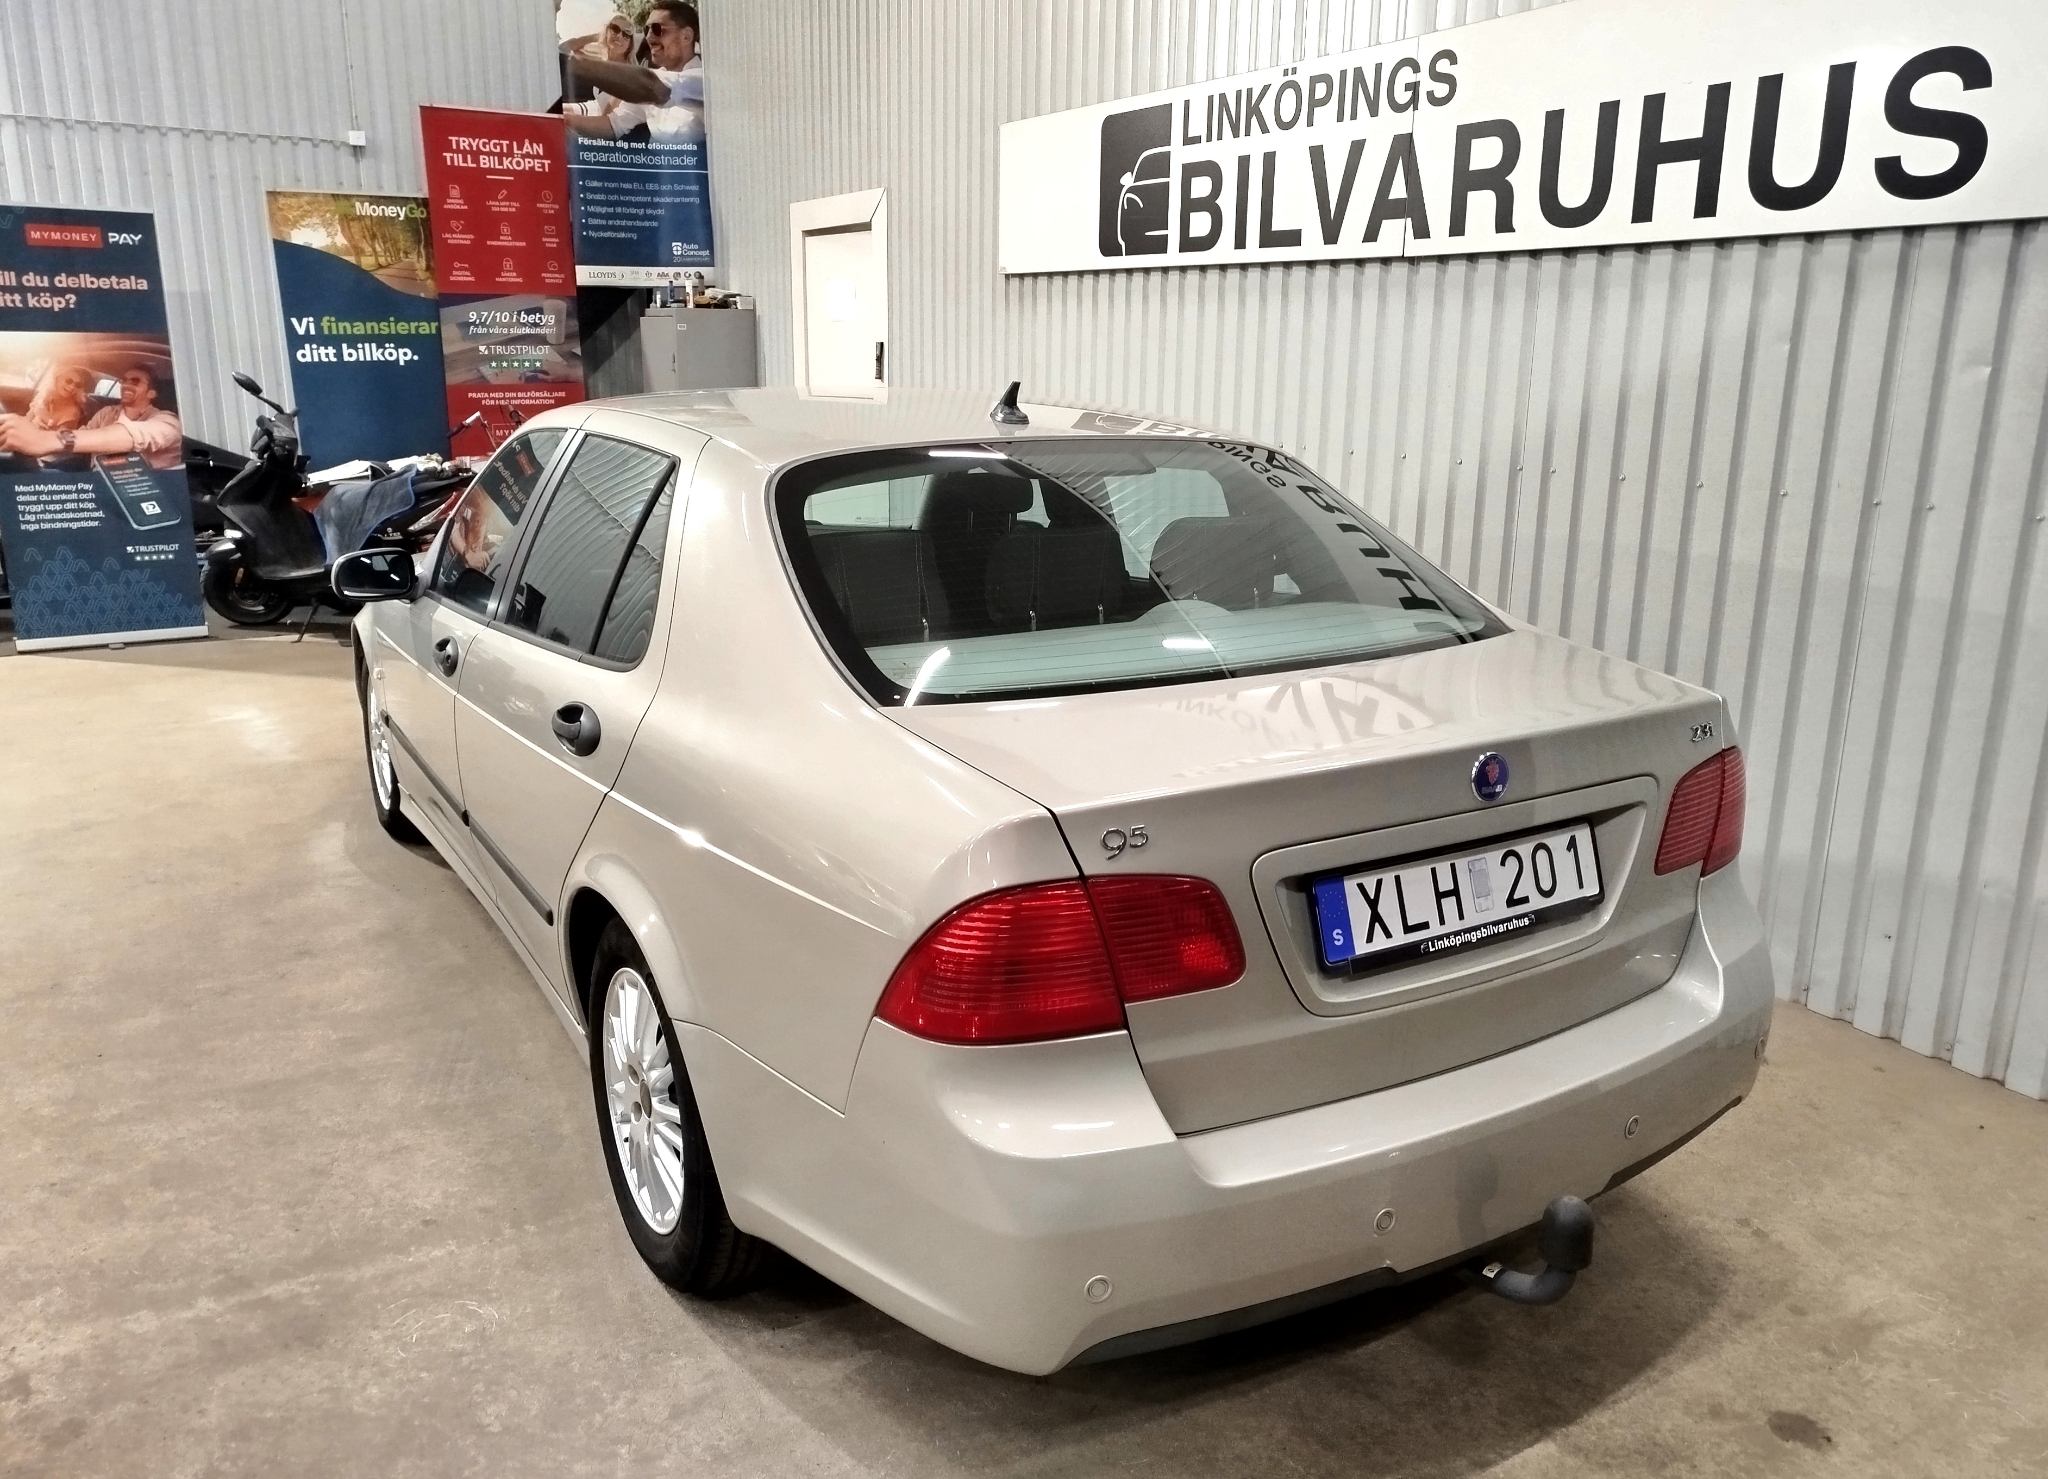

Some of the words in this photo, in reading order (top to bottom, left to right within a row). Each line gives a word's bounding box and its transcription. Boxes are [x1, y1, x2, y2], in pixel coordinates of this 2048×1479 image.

[1182, 49, 1458, 146] LINKÖPINGS
[448, 136, 510, 153] TRYGGT
[512, 139, 544, 156] LÅN
[579, 137, 615, 147] Försäkra
[615, 139, 629, 150] dig
[630, 141, 646, 149] mot
[647, 142, 698, 151] oförutsedda
[1178, 46, 1992, 253] BILVARUHUS
[442, 152, 477, 168] TILL
[479, 154, 551, 172] BILKÖPET
[579, 150, 698, 166] reparationskostnader
[584, 180, 603, 188] Gäller
[355, 202, 427, 220] MoneyGo
[645, 208, 665, 216] skydd
[30, 230, 97, 242] MYMONEY
[108, 232, 142, 245] PAY
[682, 249, 710, 257] Concept
[22, 271, 49, 287] du
[54, 273, 148, 291] delbetala
[27, 292, 77, 312] köp?
[468, 311, 510, 325] 9,7/10
[512, 312, 518, 323] i
[520, 312, 556, 326] betyg
[290, 316, 316, 336] Vi
[320, 316, 439, 335] finansierar
[468, 326, 488, 335] från
[489, 326, 508, 334] våra
[509, 326, 556, 334] slutkunder!
[296, 343, 337, 363] ditt
[341, 343, 419, 366] bilköp.
[489, 345, 550, 355] TRUSTPILOT
[517, 390, 566, 398] BILFÖRSÄLJARE
[481, 398, 495, 406] FÖR
[14, 484, 34, 492] Med
[35, 484, 76, 492] MyMoney
[77, 483, 93, 491] Pay
[16, 494, 38, 502] delar
[52, 493, 78, 501] enkelt
[17, 503, 44, 512] tryggt
[45, 503, 62, 511] upp
[79, 501, 97, 509] köp.
[19, 513, 36, 521] Låg
[20, 523, 39, 531] inga
[134, 544, 180, 552] TRUSTPILOT
[1355, 861, 1466, 945] XLH
[1499, 834, 1586, 909] 201
[1332, 927, 1345, 947] S
[1428, 916, 1530, 952] Linköpingsbilvaruhus
